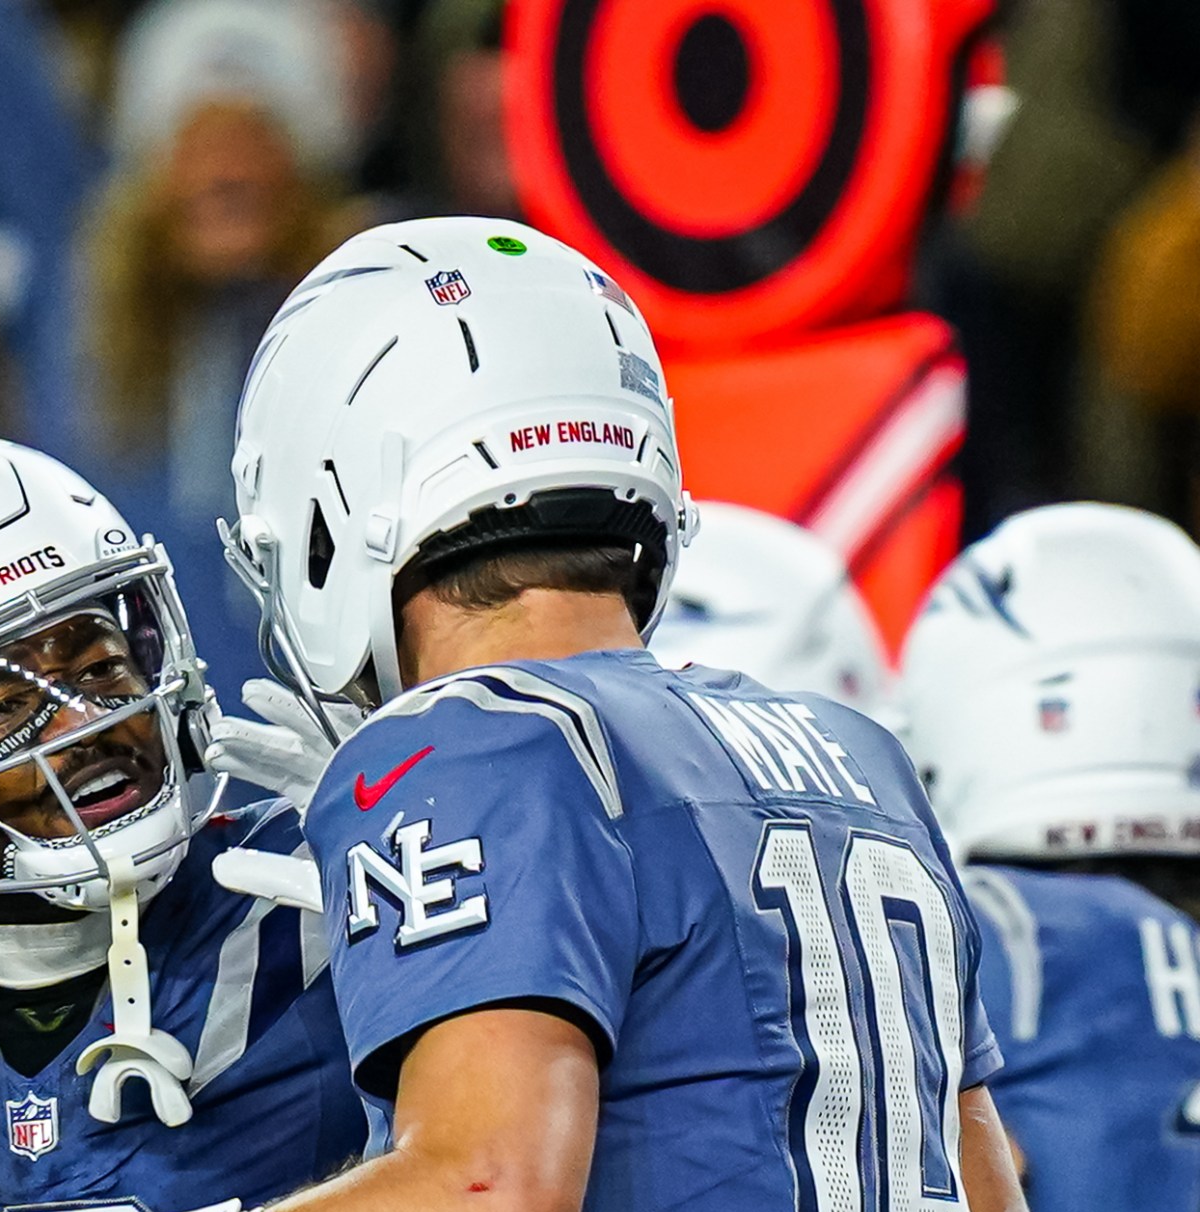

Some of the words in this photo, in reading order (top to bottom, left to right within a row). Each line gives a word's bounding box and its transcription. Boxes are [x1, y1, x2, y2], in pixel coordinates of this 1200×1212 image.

[433, 281, 468, 303] NFL
[509, 424, 551, 453] NEW
[557, 421, 635, 450] ENGLAND
[686, 691, 877, 806] MAYE
[346, 818, 492, 956] NE
[15, 1122, 51, 1150] NFL
